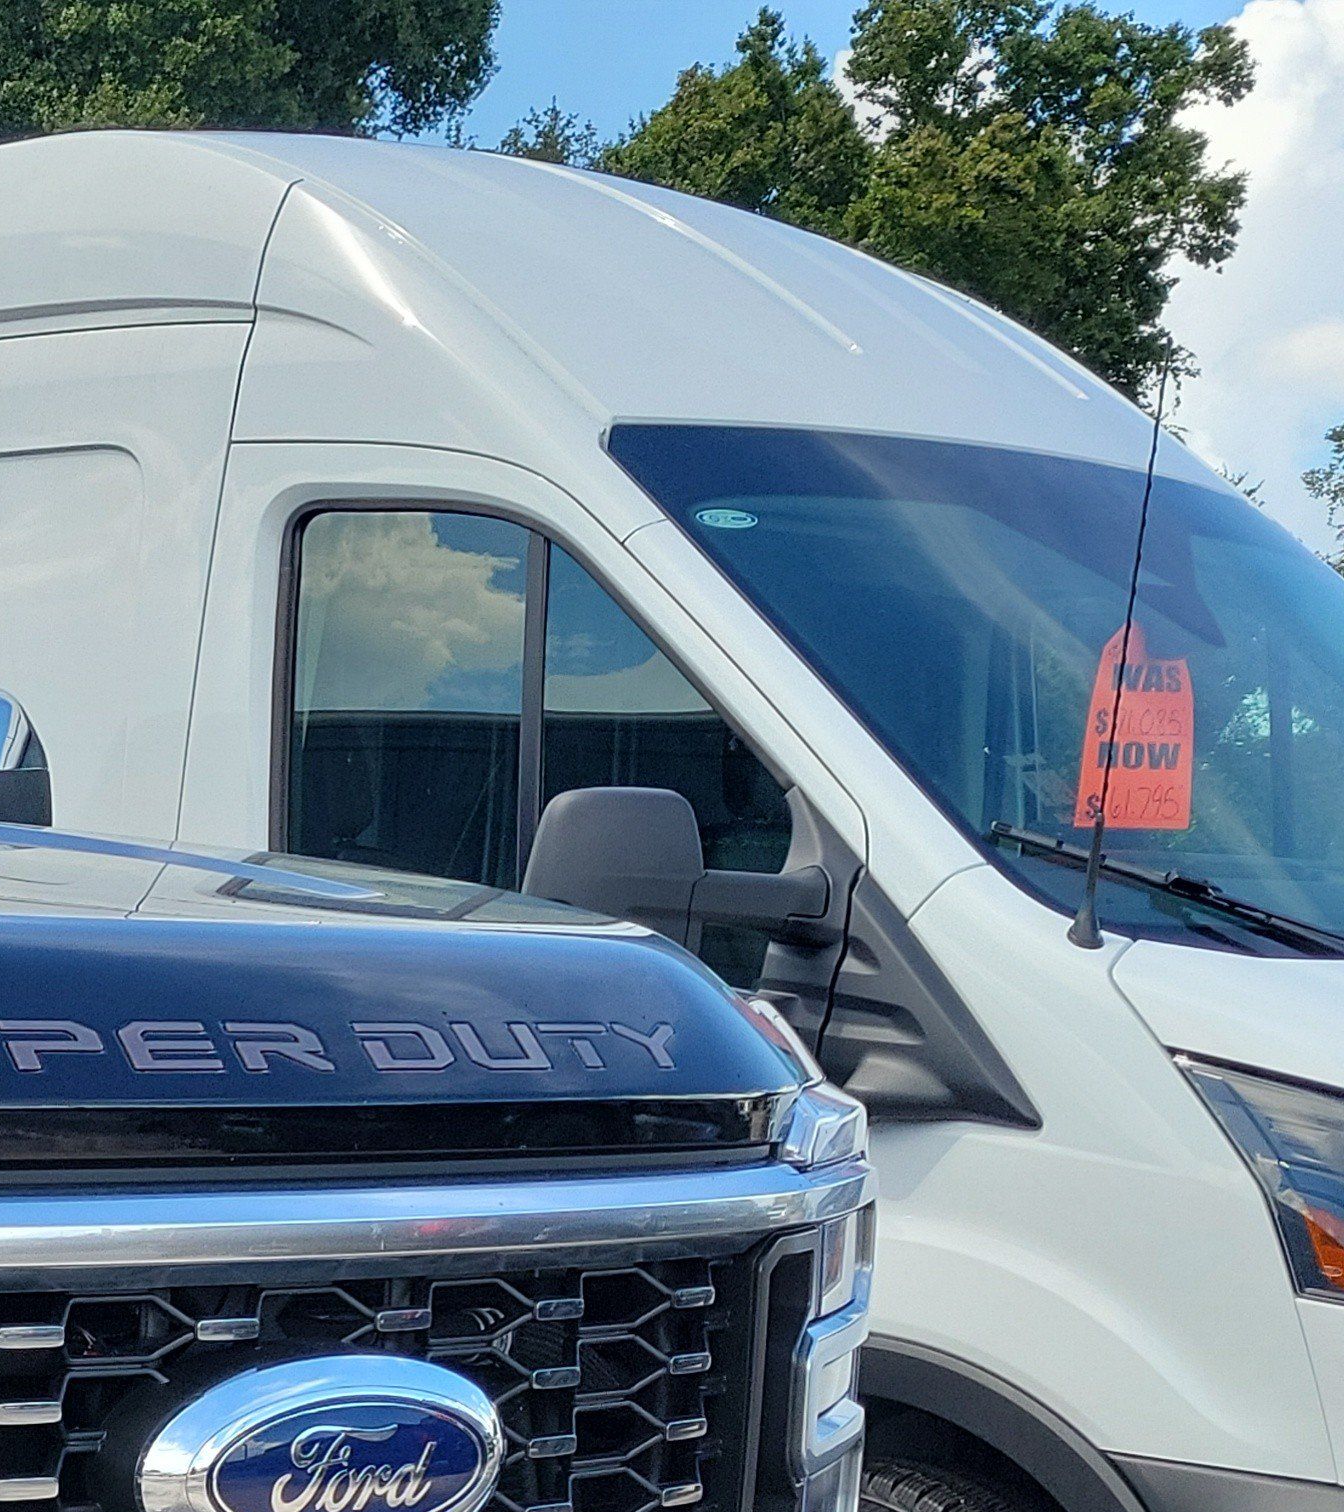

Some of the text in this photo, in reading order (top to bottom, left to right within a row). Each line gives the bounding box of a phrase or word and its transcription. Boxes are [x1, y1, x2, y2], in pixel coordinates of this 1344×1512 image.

[1111, 662, 1182, 693] WAS
[1097, 741, 1182, 771] NOW
[351, 1020, 676, 1073] DUTY
